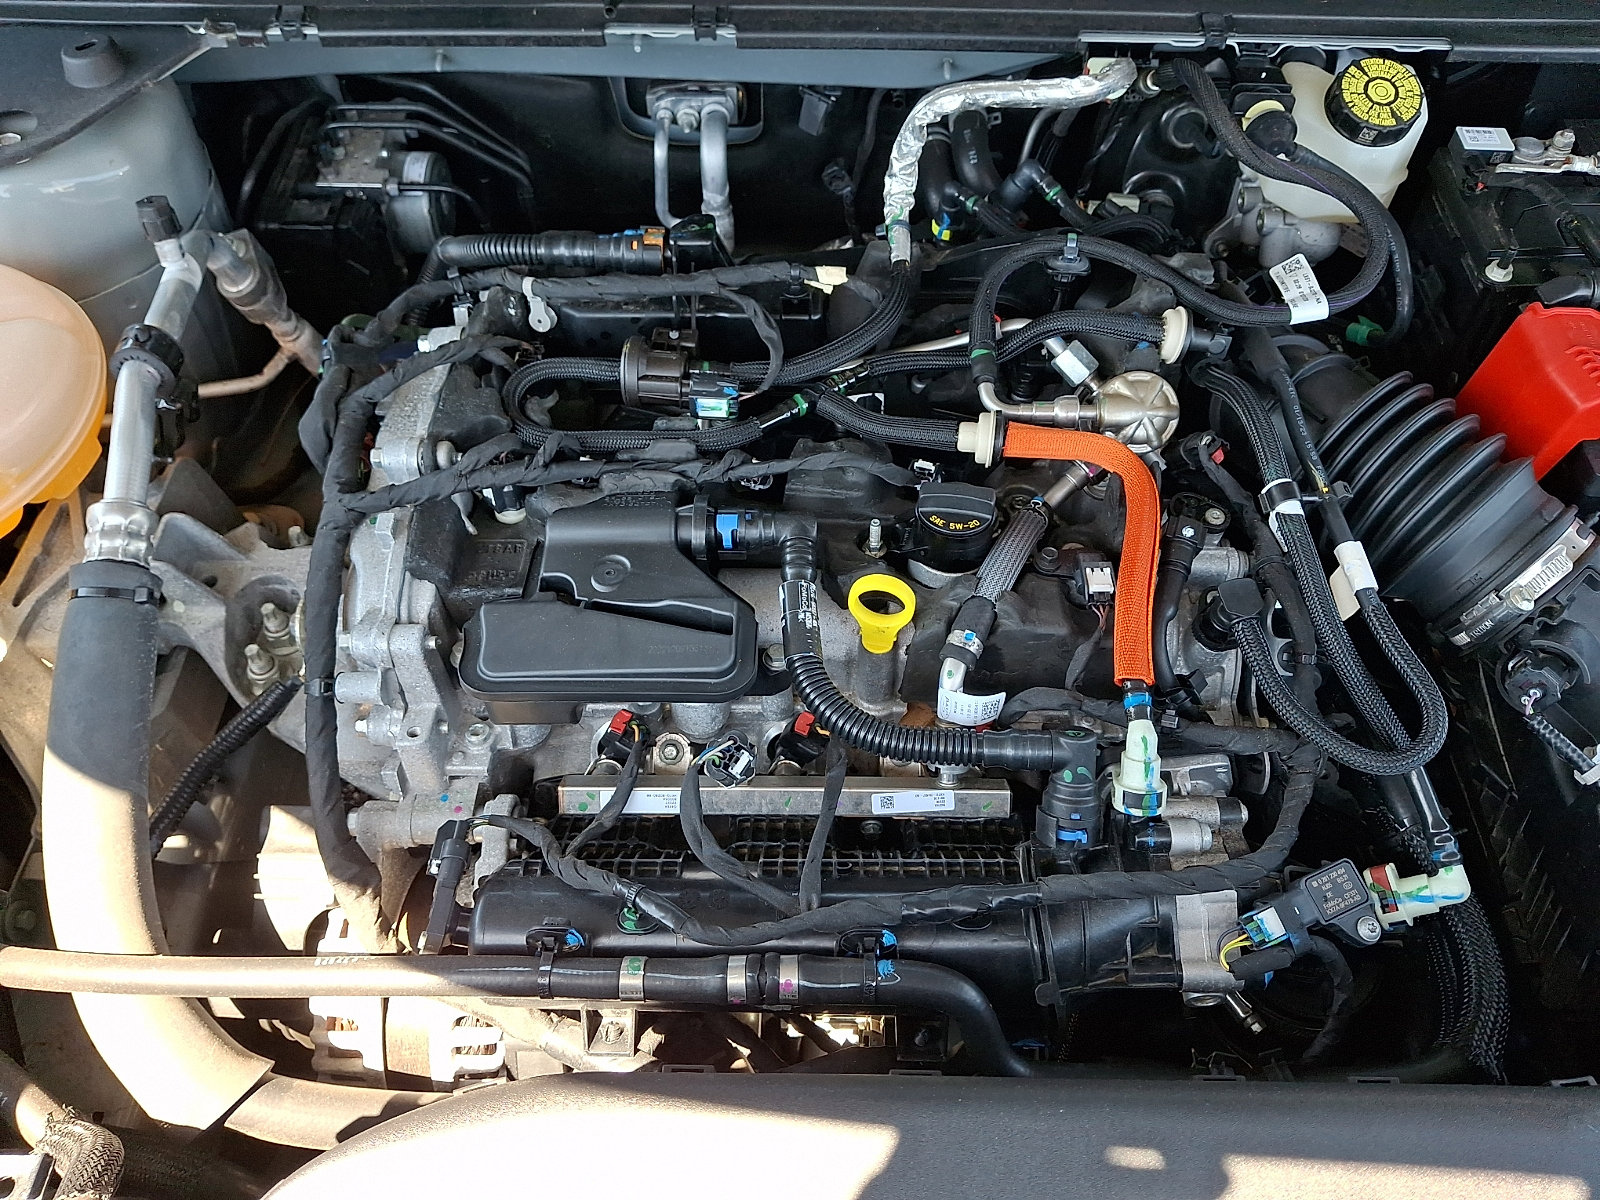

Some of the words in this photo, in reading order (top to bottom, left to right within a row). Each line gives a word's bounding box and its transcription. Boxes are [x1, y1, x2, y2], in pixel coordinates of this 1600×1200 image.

[929, 514, 946, 527] SAE
[949, 519, 980, 530] 5W-20
[1470, 618, 1494, 638] TRIDON
